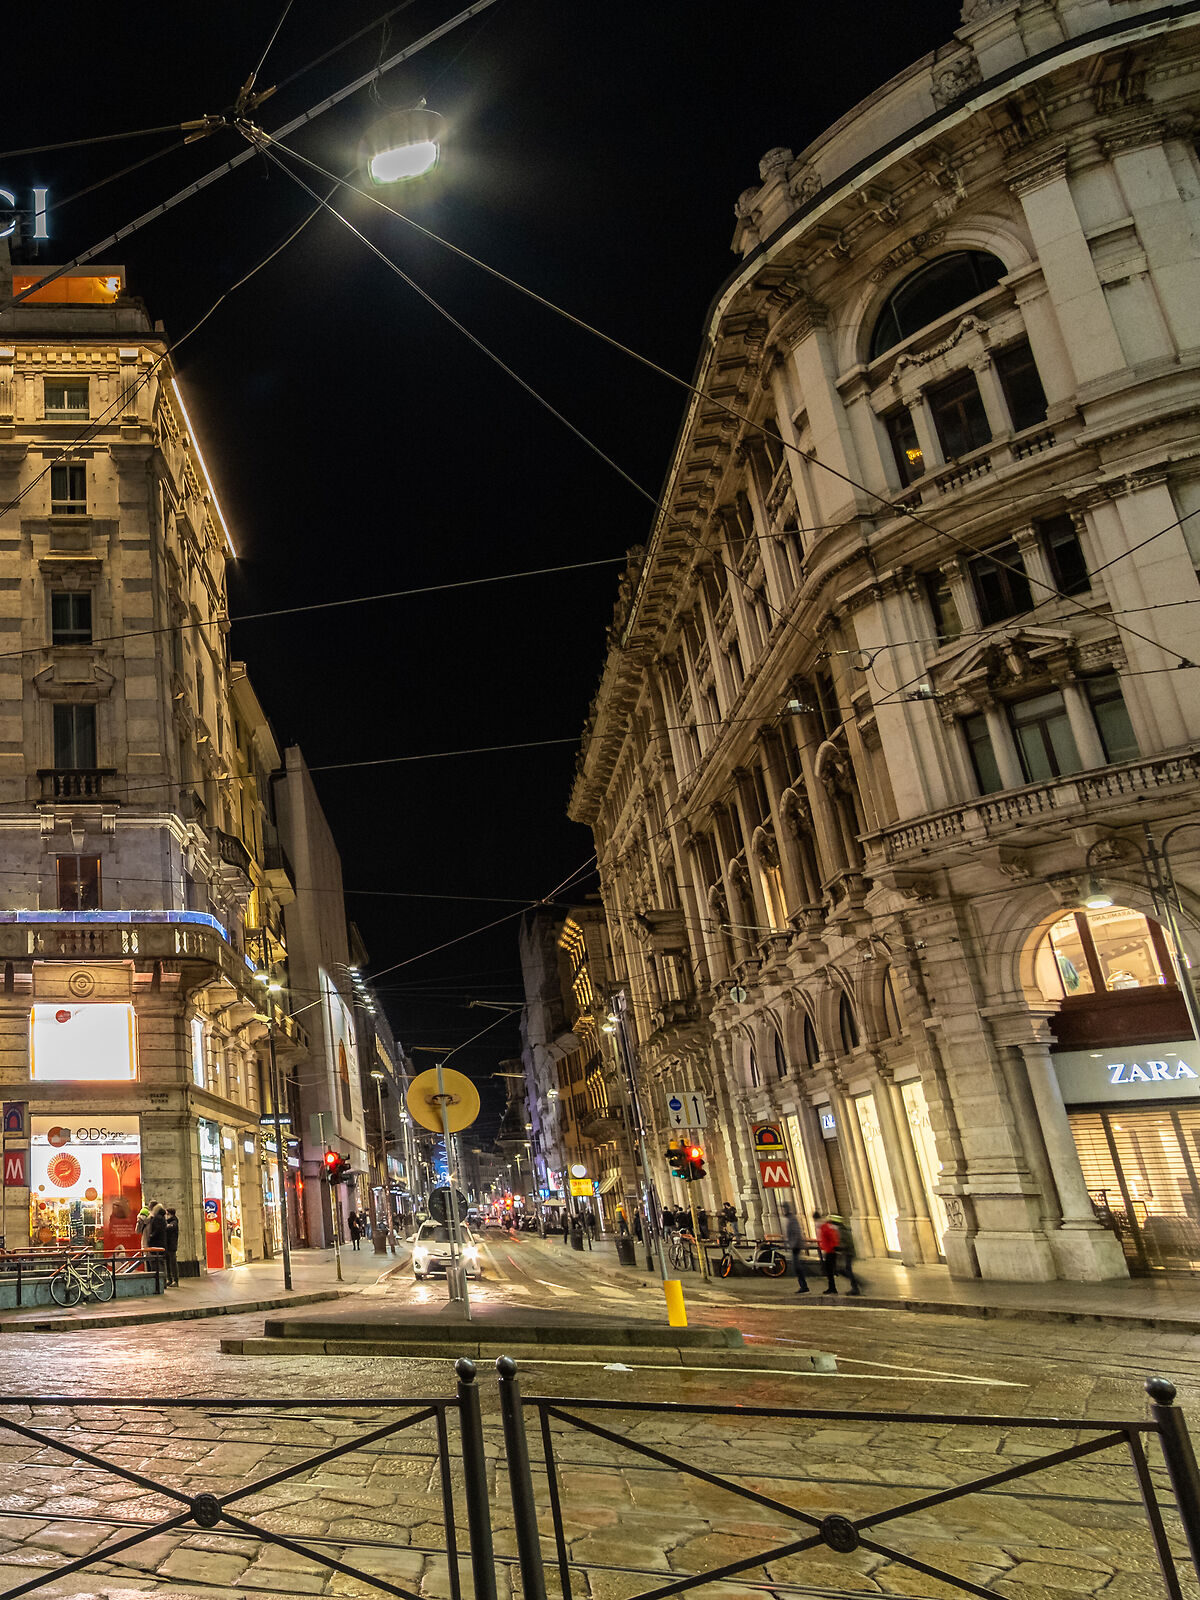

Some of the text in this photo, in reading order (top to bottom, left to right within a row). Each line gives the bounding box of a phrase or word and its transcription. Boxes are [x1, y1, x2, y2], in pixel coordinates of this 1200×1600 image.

[1107, 1060, 1198, 1084] ZARA
[76, 1127, 125, 1141] ODStore
[5, 1158, 24, 1180] M
[763, 1165, 789, 1183] M
